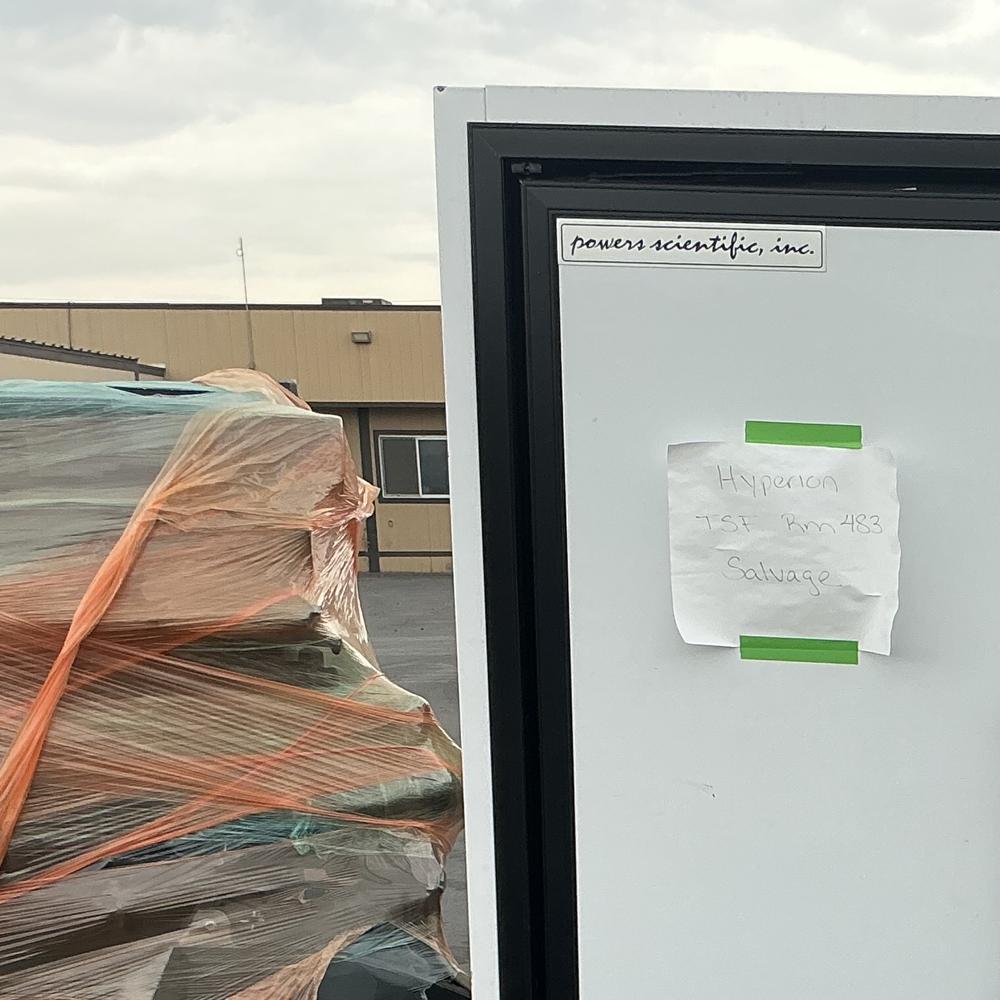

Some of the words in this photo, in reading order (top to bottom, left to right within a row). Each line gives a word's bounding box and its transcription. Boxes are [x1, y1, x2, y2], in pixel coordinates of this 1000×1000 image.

[570, 234, 645, 256] powers
[650, 231, 764, 260] scientific,
[769, 237, 815, 256] inc.
[716, 464, 839, 498] Hyperion
[695, 513, 758, 533] TSF
[780, 512, 836, 534] Rm
[840, 513, 883, 535] 483
[726, 555, 843, 597] Salvage
